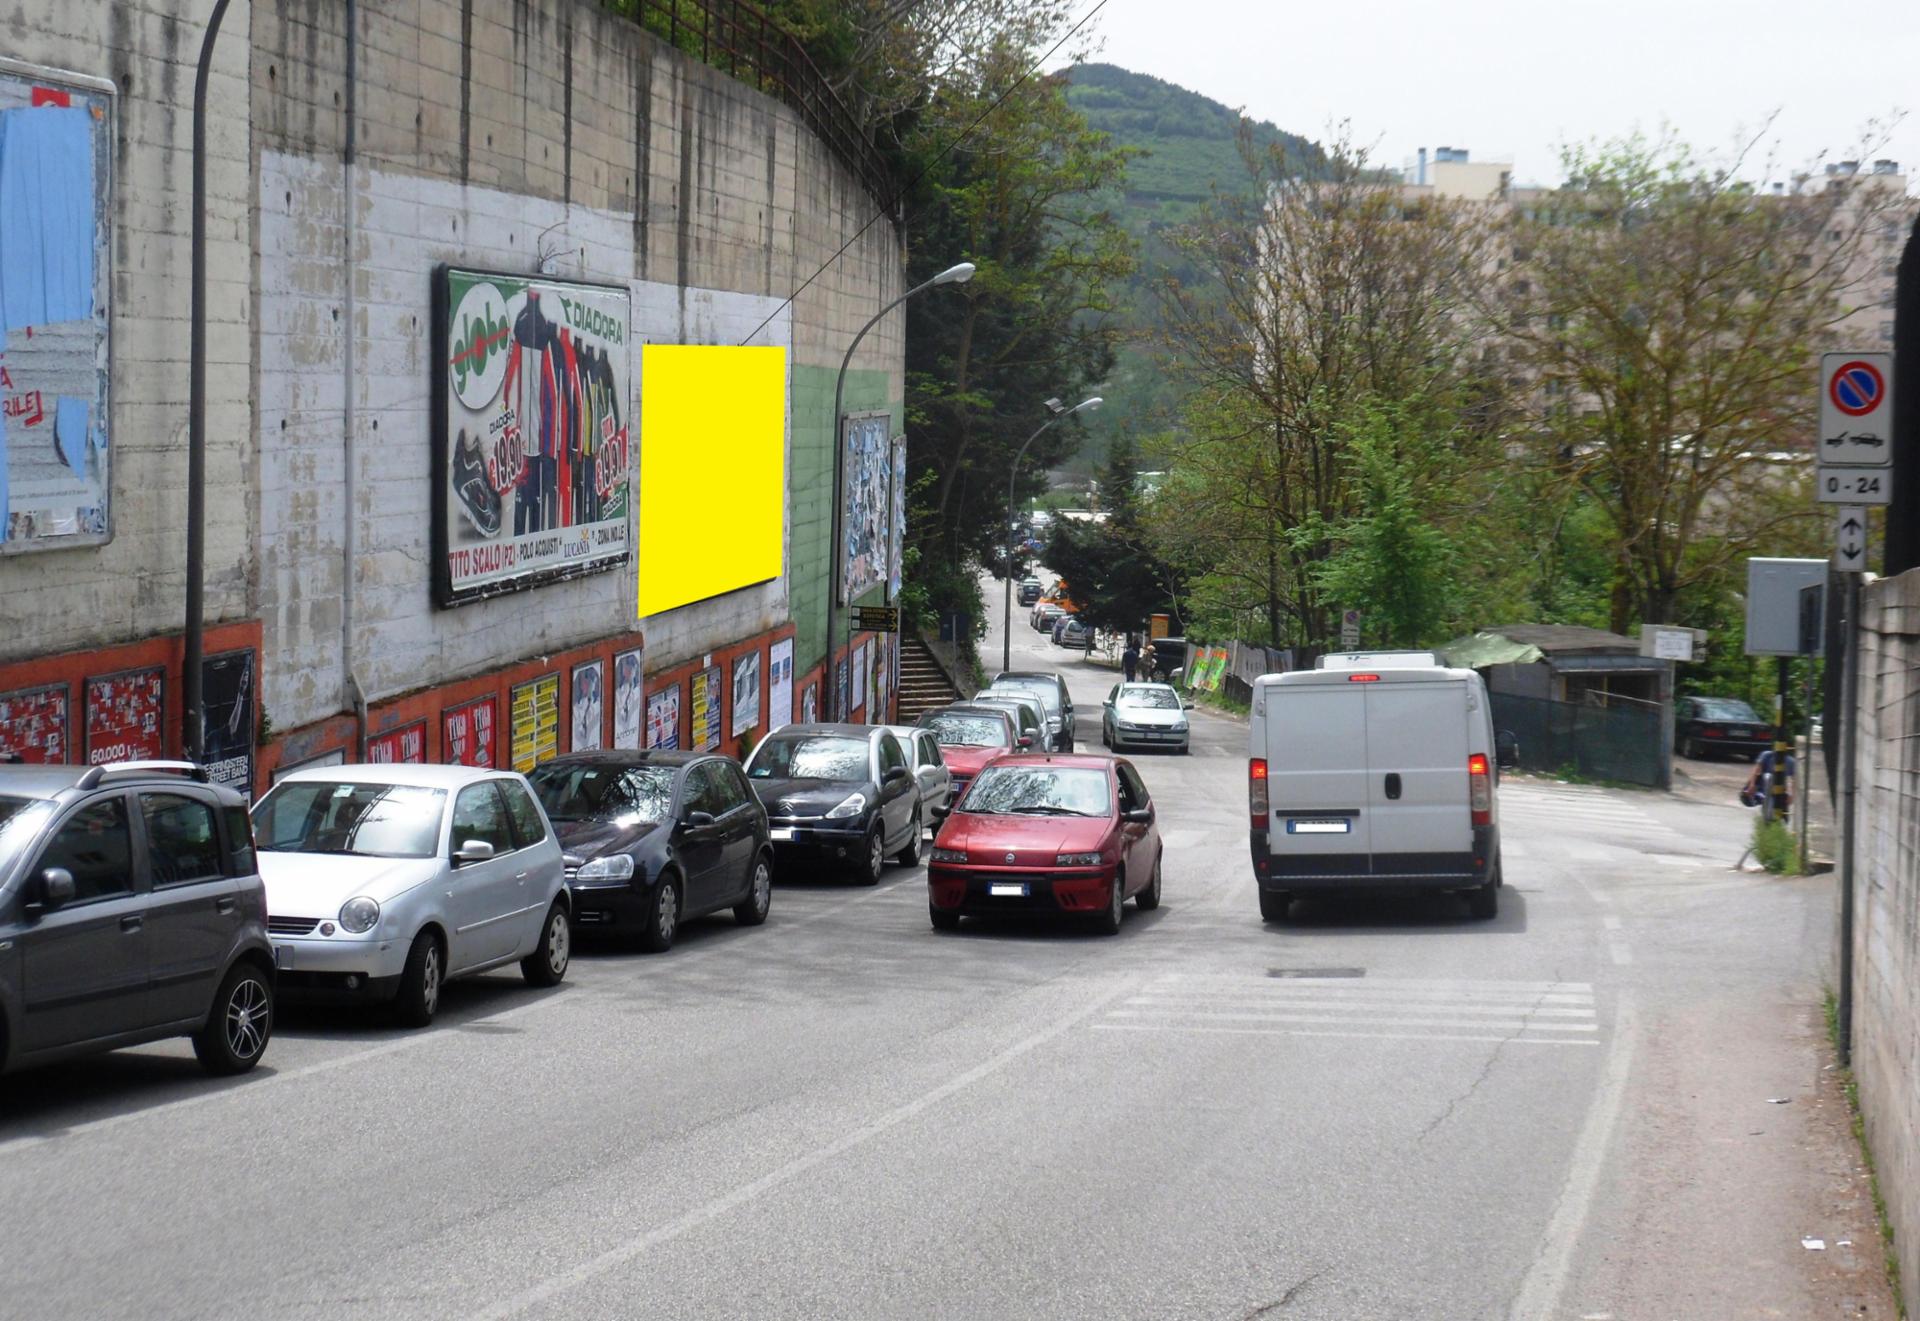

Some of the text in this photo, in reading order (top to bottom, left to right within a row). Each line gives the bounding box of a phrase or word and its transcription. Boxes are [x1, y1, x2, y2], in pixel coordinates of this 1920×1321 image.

[574, 301, 623, 346] DIADORA
[453, 301, 508, 396] globo
[489, 408, 515, 435] DIADORA
[1827, 477, 1838, 494] 0
[1856, 477, 1881, 494] 24
[448, 550, 469, 578] TITO
[473, 544, 500, 574] SCALO
[502, 543, 516, 570] (PZ)
[520, 541, 533, 561] POLO
[535, 537, 559, 557] ACQUISTI
[91, 743, 125, 764] 60.000
[231, 765, 248, 779] BAND
